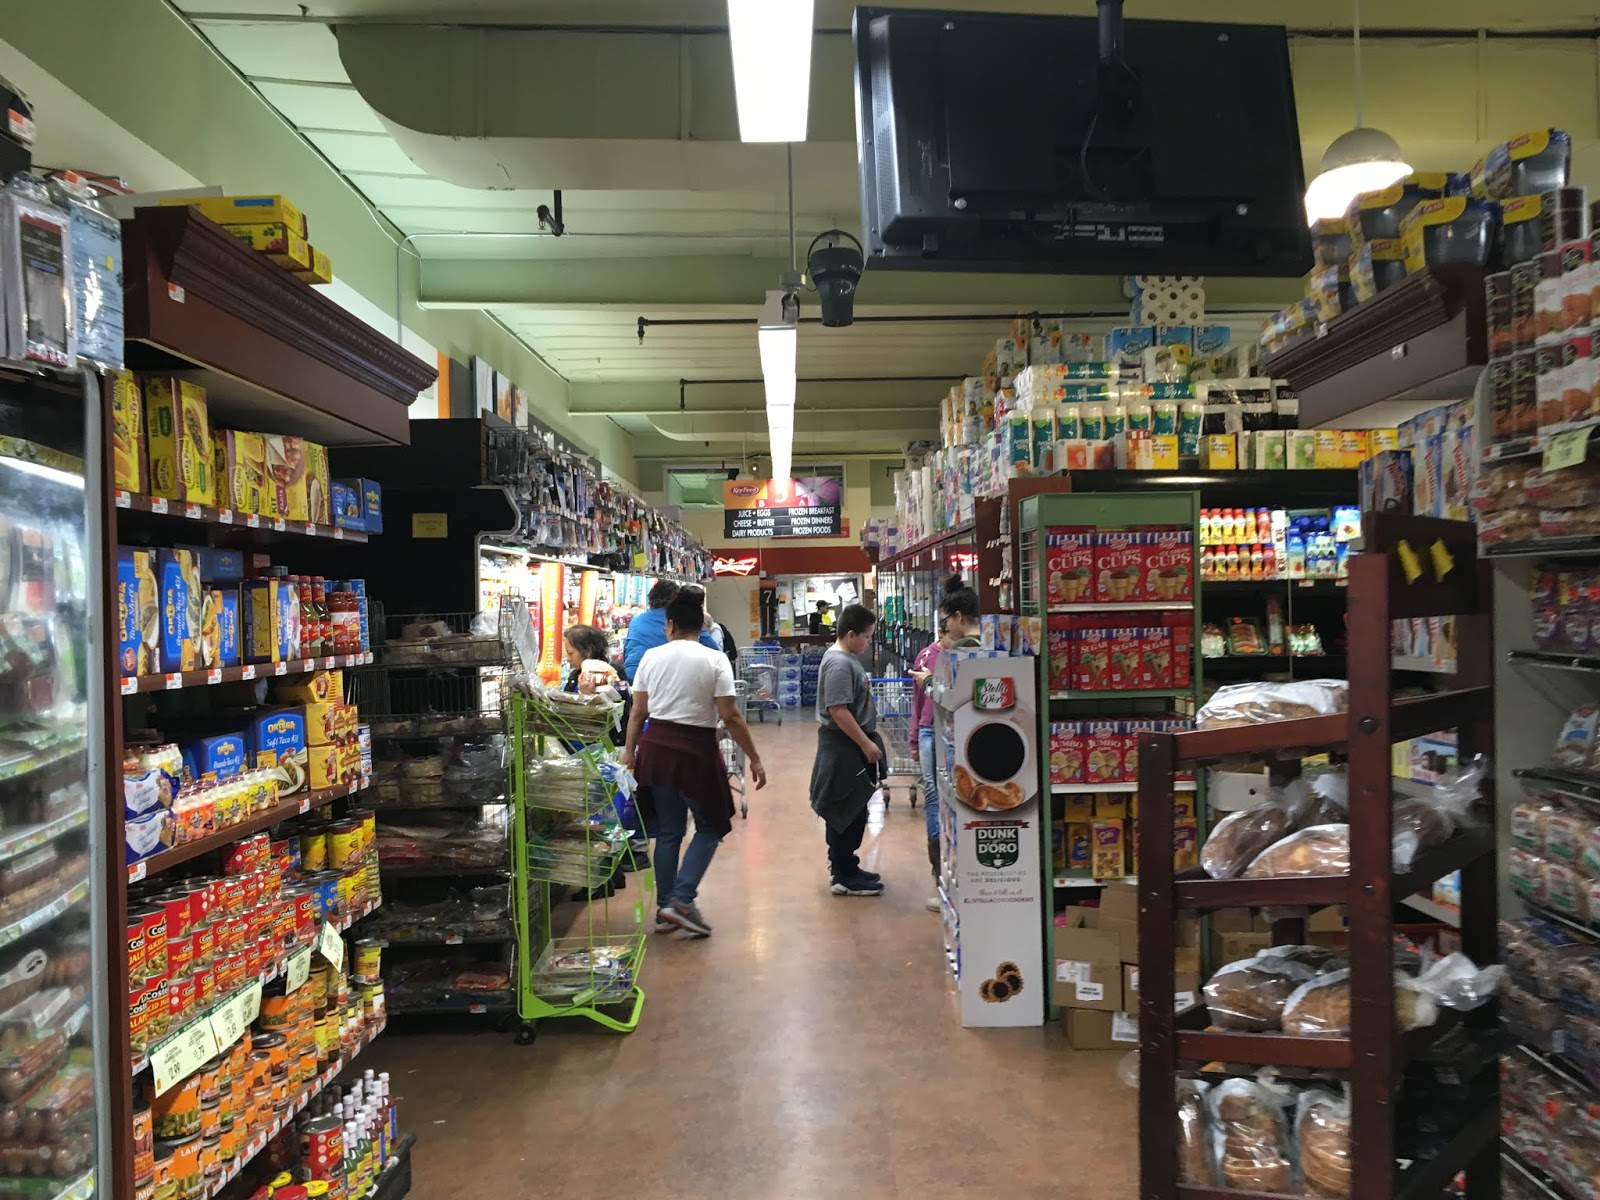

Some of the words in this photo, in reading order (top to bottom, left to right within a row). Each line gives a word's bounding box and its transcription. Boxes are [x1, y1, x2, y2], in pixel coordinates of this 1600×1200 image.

[758, 500, 765, 508] B
[798, 499, 806, 507] A
[738, 510, 752, 518] JUICE
[756, 509, 771, 517] EGGS
[788, 507, 808, 516] FROZEN
[809, 506, 835, 515] BREAKFAST
[733, 519, 752, 528] CHEESE
[756, 518, 775, 527] BUTTER
[790, 517, 810, 525] FROZEN
[811, 516, 833, 525] DINNERS
[732, 529, 746, 538] DAIRY
[746, 528, 774, 537] PRODUCTS
[792, 526, 812, 535] FROZEN
[813, 526, 831, 534] FOODS
[1048, 554, 1093, 571] CUPS
[1097, 553, 1142, 571] CUPS
[1146, 552, 1191, 569] CUPS
[763, 589, 773, 604] 7
[165, 588, 175, 635] ORTEGA
[546, 624, 555, 632] &
[1050, 641, 1068, 651] GAR
[1081, 640, 1108, 653] SUGAR
[1112, 640, 1139, 652] SUGAR
[1142, 640, 1170, 652] SUGAR
[545, 637, 555, 668] Butter
[268, 718, 296, 734] ORTEGA
[266, 738, 278, 748] Soft
[279, 736, 291, 744] Taco
[291, 734, 299, 743] Kit
[1050, 740, 1083, 751] JUMBO
[1087, 739, 1121, 750] JUMBO
[978, 829, 1016, 839] DUNK
[978, 843, 1017, 853] D'ORO
[180, 1148, 190, 1157] LA
